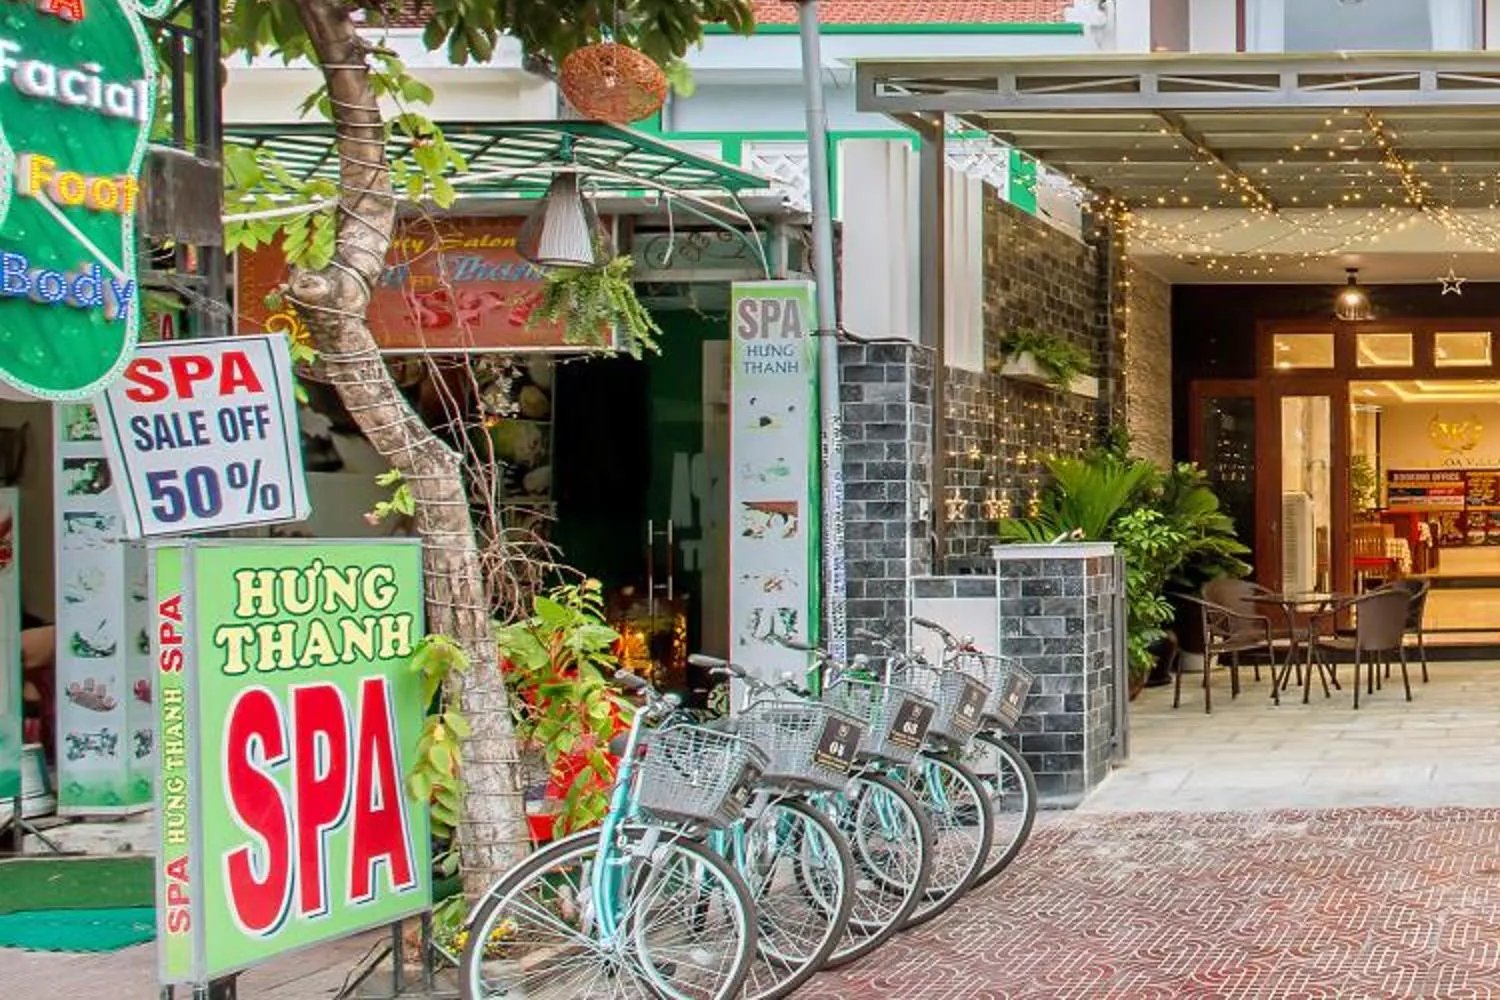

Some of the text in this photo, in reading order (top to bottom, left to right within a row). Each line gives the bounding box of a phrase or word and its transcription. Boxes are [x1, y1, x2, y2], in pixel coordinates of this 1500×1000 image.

[0, 38, 149, 121] Facial
[26, 154, 139, 216] Foot
[1, 252, 136, 319] Body
[738, 299, 802, 340] SPA
[123, 351, 264, 403] SPA
[744, 360, 799, 374] THANH
[131, 404, 270, 453] SALE OFF
[146, 459, 281, 524] 50%
[233, 558, 399, 620] HƯNG
[160, 595, 184, 673] SPA
[214, 612, 415, 676] THANH
[163, 687, 185, 771] THANH
[225, 676, 415, 935] SPA
[167, 855, 191, 934] SPA
